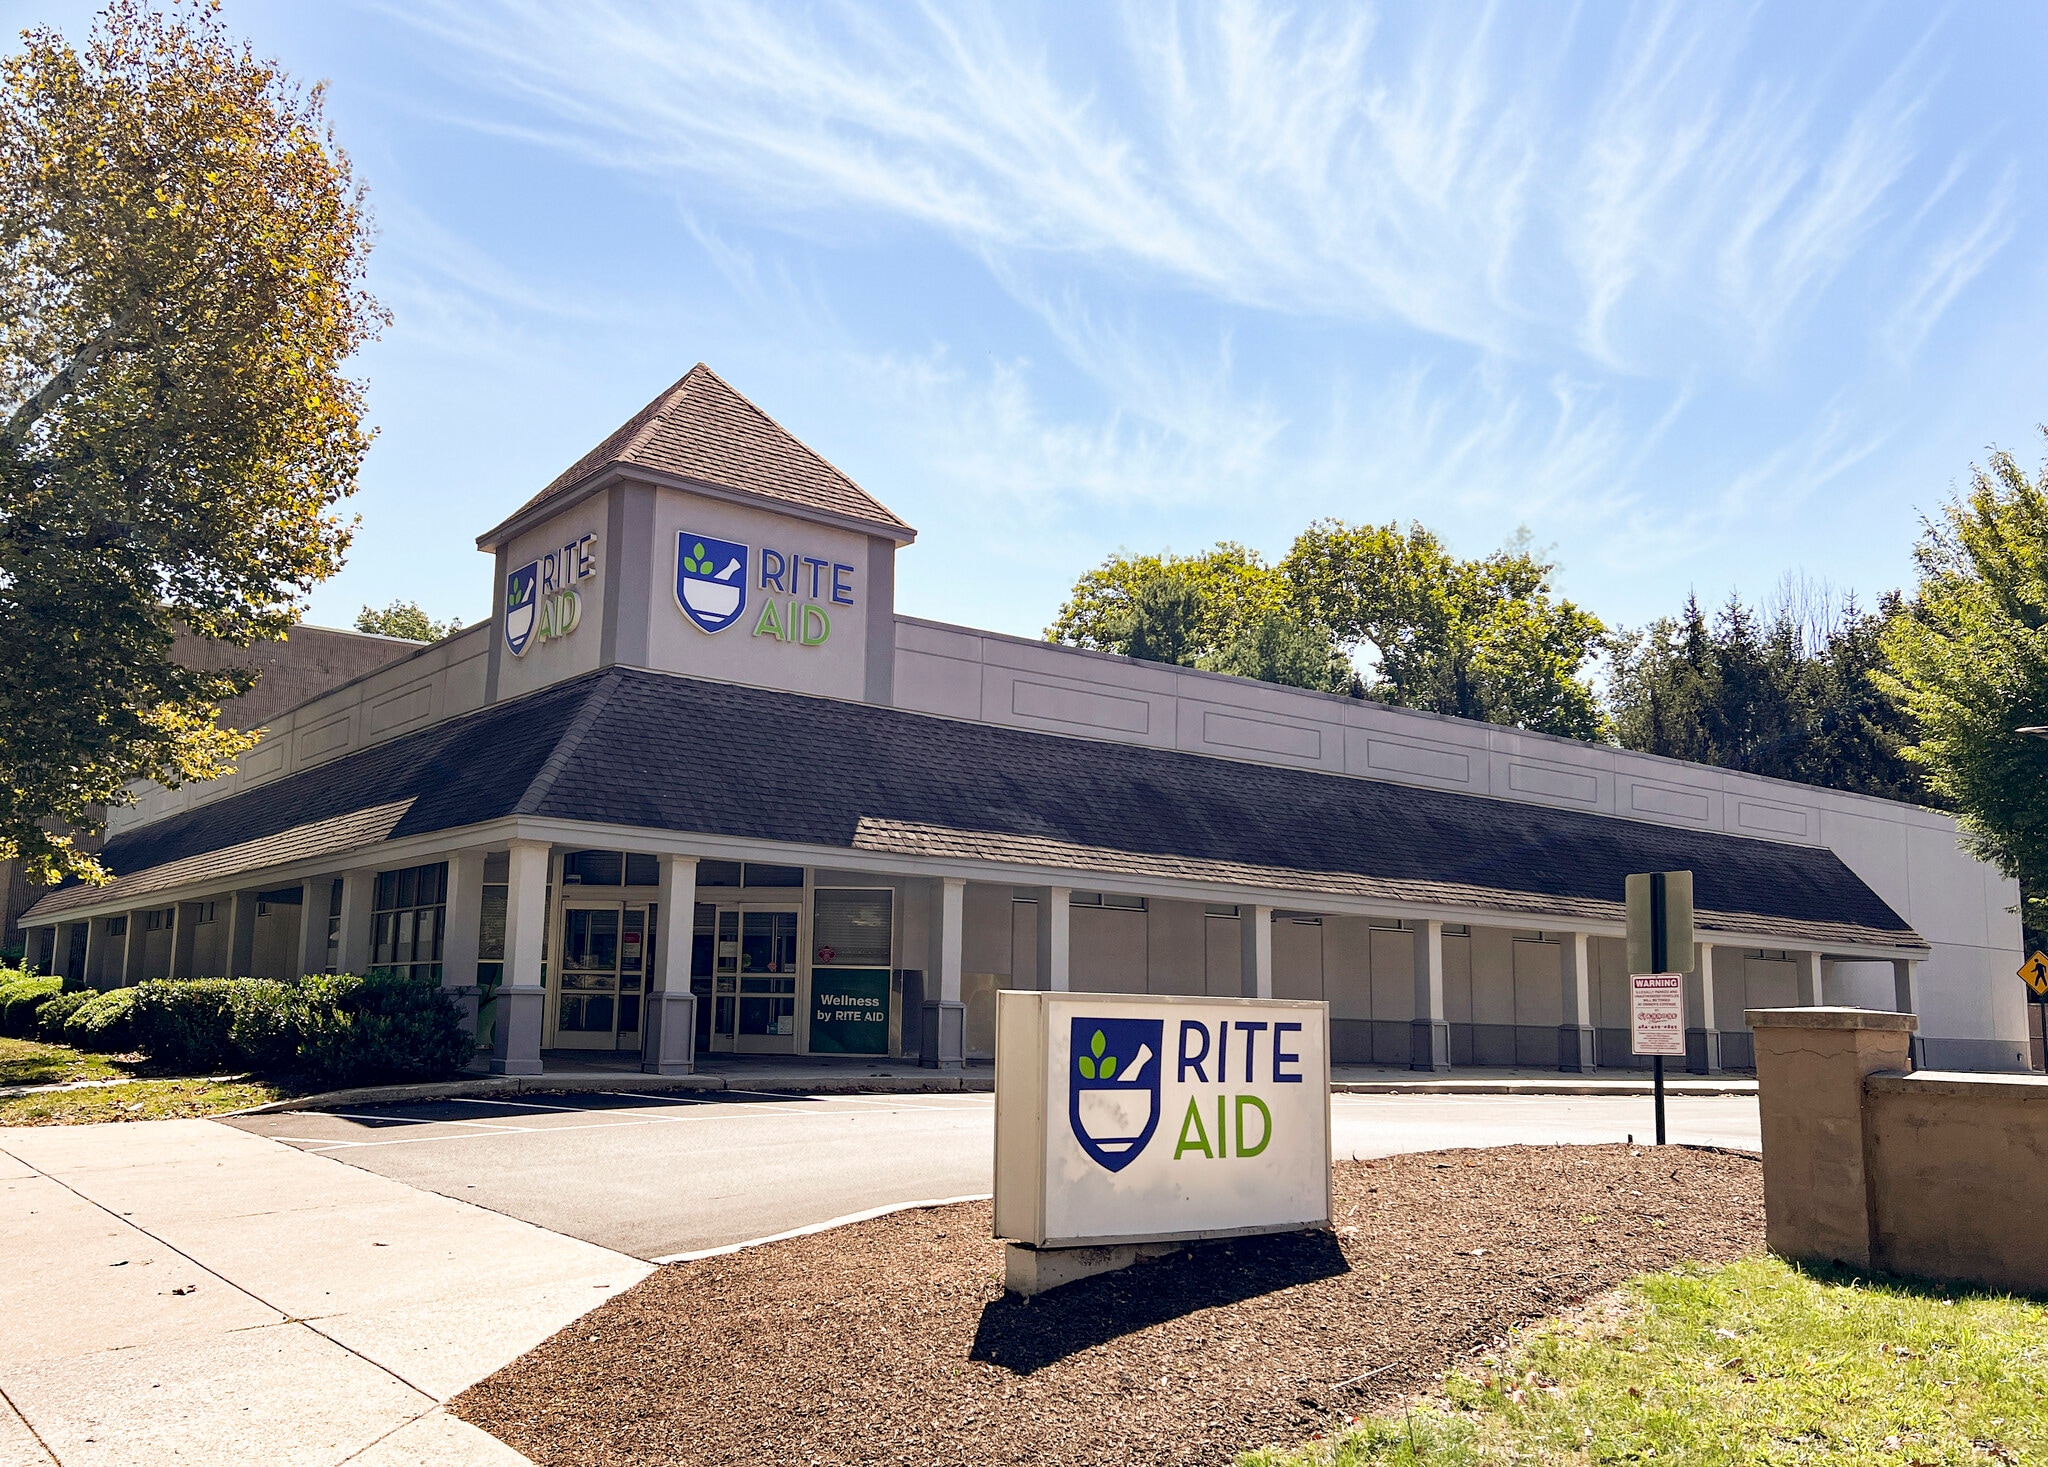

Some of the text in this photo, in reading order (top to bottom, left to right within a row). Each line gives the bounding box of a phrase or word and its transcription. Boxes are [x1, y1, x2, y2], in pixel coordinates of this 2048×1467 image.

[542, 533, 597, 596] RITE
[759, 548, 855, 606] RITE
[537, 590, 581, 643] AID
[752, 597, 831, 646] AID
[820, 994, 880, 1007] Wellness
[1635, 979, 1678, 988] WARNING
[817, 1010, 884, 1022] by RITE AID
[1177, 1020, 1303, 1083] RITE
[1173, 1095, 1272, 1160] AID
